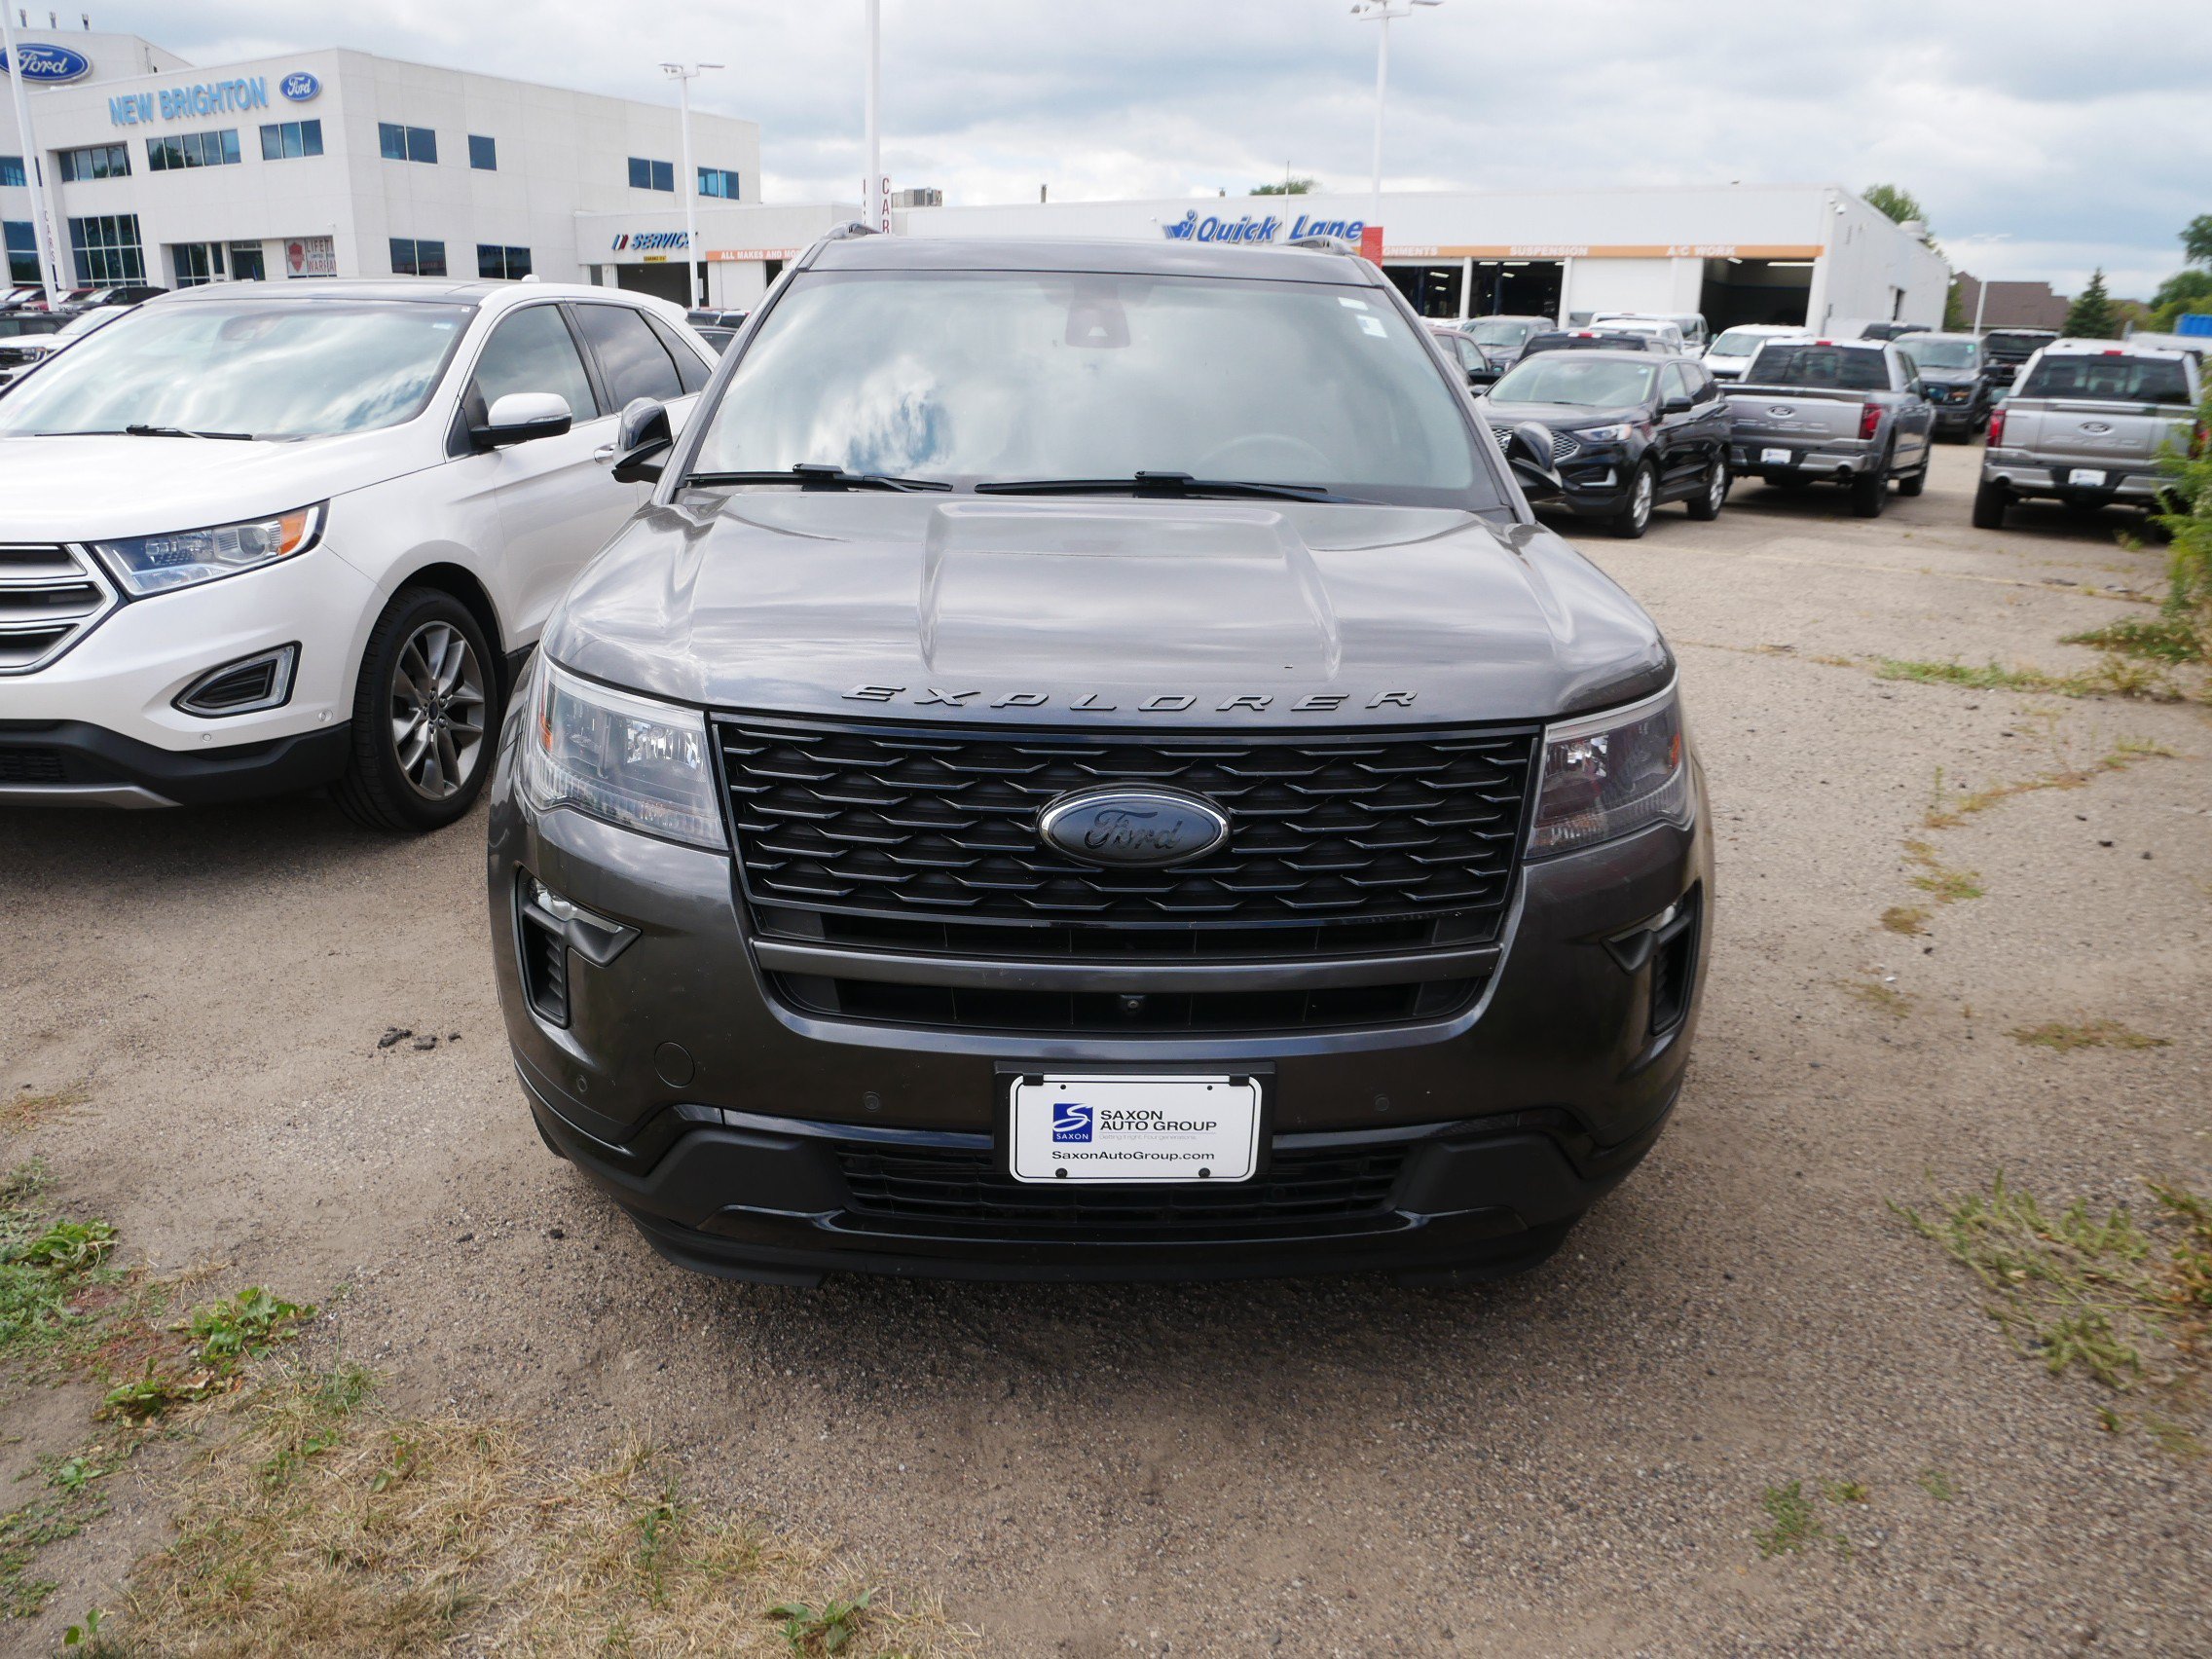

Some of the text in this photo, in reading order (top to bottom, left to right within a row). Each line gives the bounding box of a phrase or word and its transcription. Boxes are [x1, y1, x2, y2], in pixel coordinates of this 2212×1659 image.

[18, 49, 68, 73] Ford
[287, 76, 312, 95] Ford
[108, 76, 269, 127] NEW BRIGHTON
[1197, 213, 1365, 242] Quick Lane
[720, 251, 735, 260] ALL
[737, 250, 763, 260] MAKES
[766, 249, 782, 259] AND
[1510, 245, 1588, 256] SUSPENSION
[1695, 245, 1736, 256] WORK
[841, 683, 1418, 713] EXPLORER
[1084, 809, 1183, 850] Ford
[1100, 1110, 1163, 1121] SAXON
[1099, 1121, 1217, 1131] AUTO GROUP
[1051, 1151, 1215, 1161] SaxonAutoGroup.com
